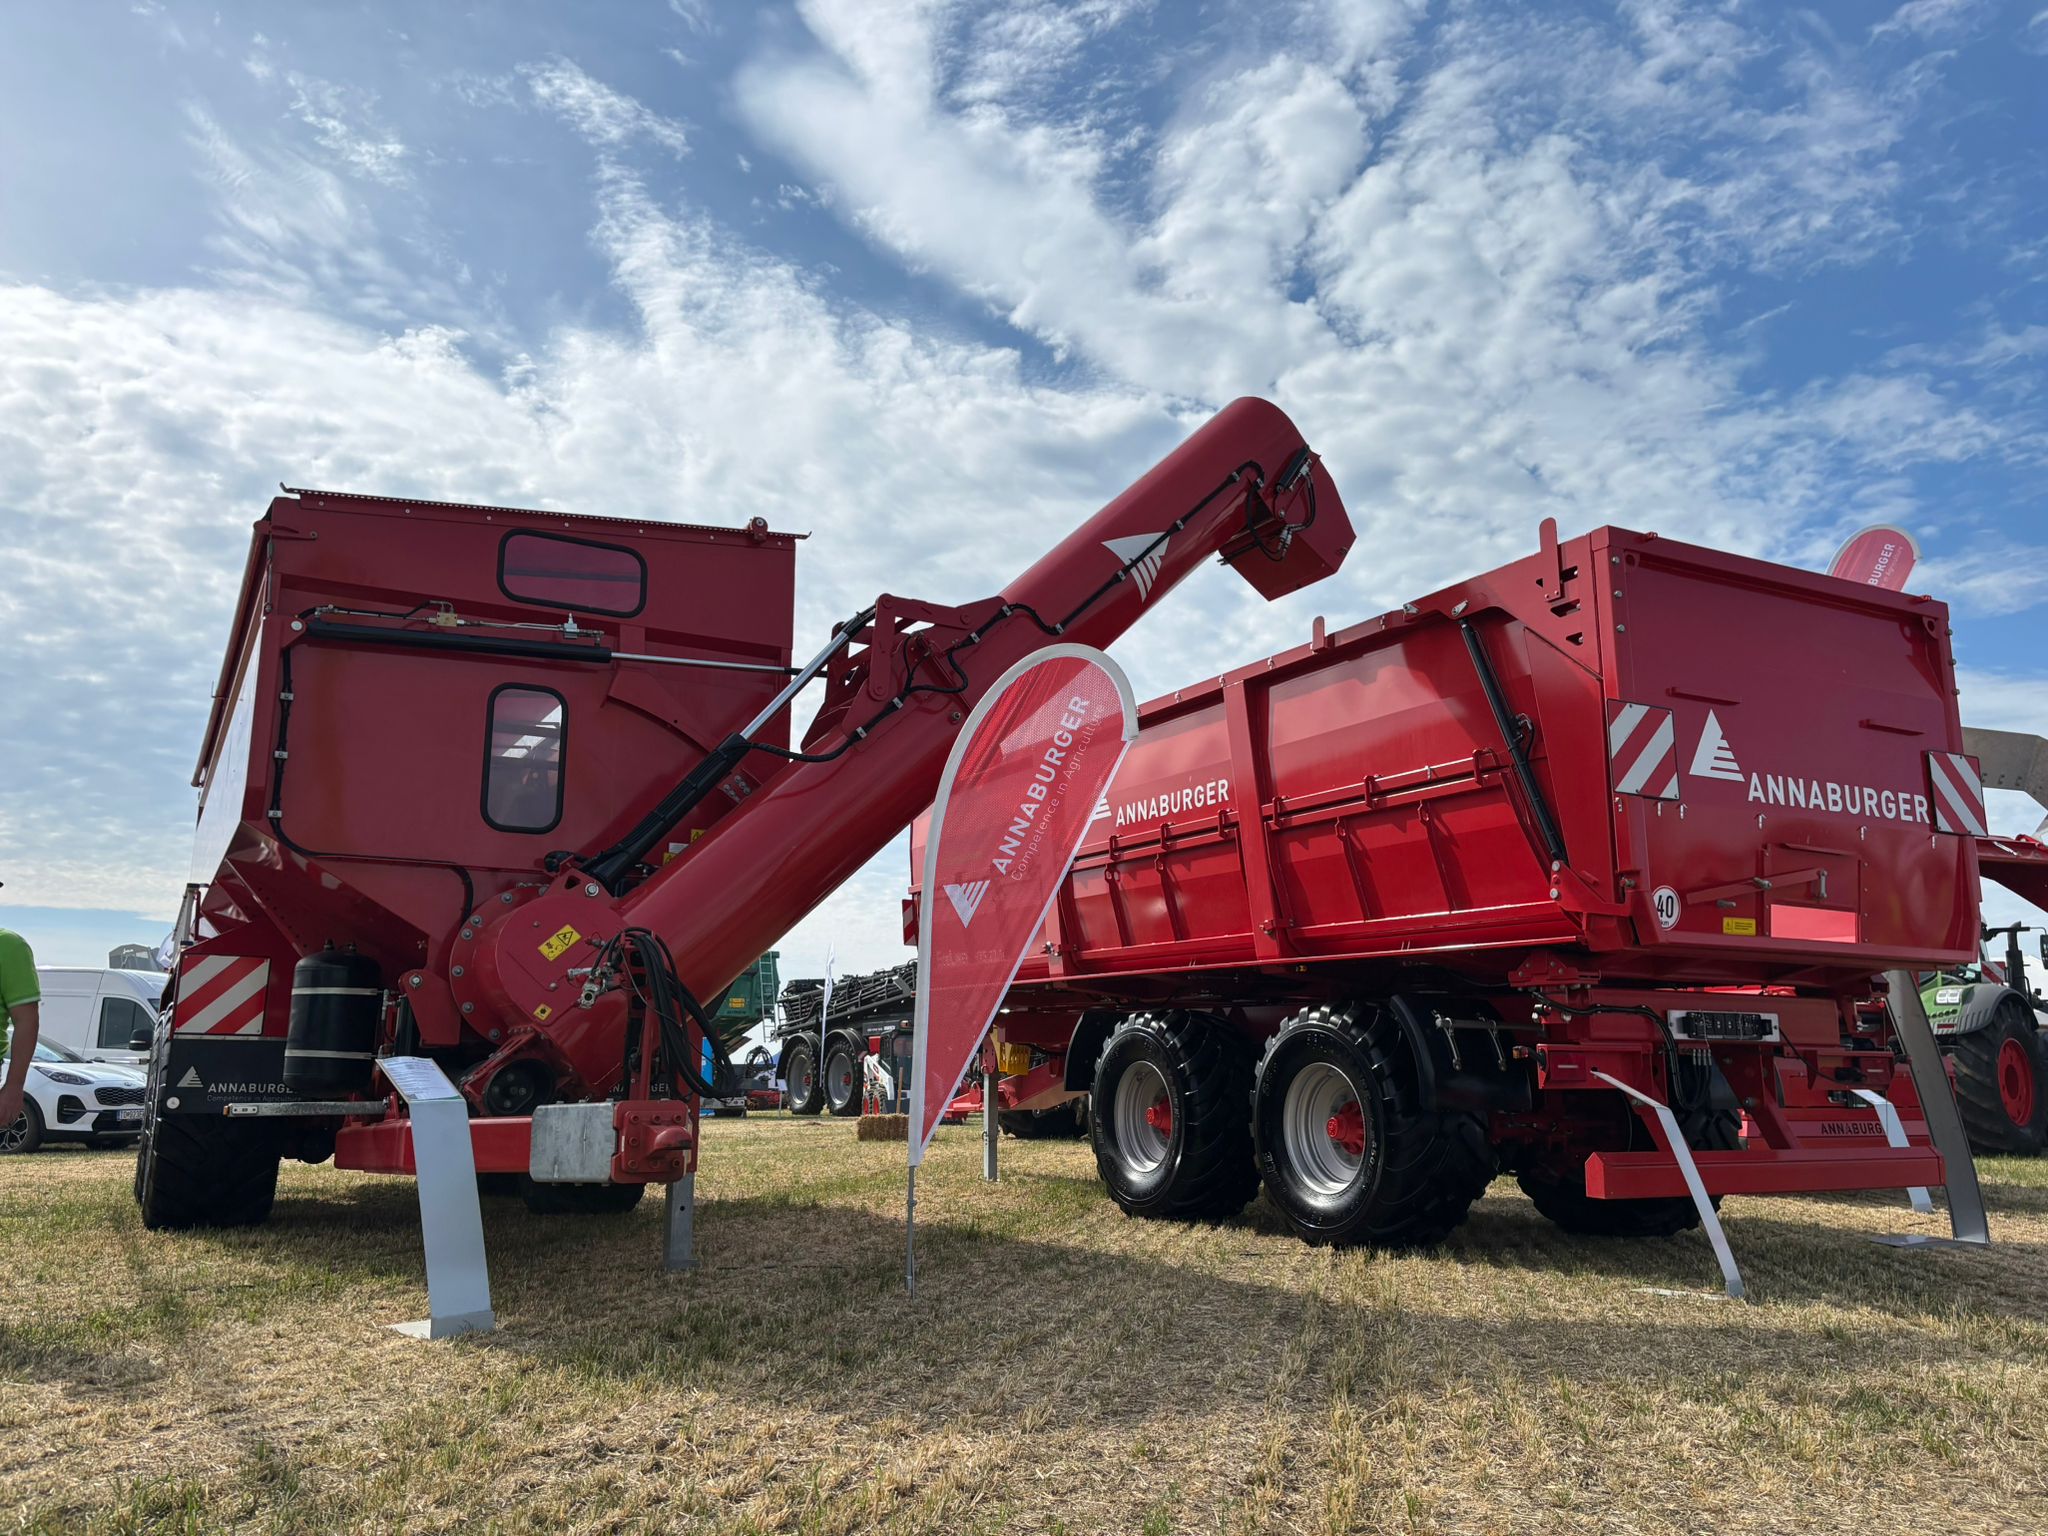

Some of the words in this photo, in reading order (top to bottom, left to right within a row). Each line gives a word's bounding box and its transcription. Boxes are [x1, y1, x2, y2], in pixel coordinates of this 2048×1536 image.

[1868, 543, 1895, 585] BURGER
[992, 696, 1090, 875] ANNABURGER
[1116, 779, 1229, 827] ANNABURGER
[1748, 772, 1931, 824] ANNABURGER
[1011, 798, 1060, 881] Competence
[1656, 895, 1674, 918] 40
[208, 1083, 297, 1094] ANNABURG
[1821, 1123, 1884, 1134] ANNABURG
